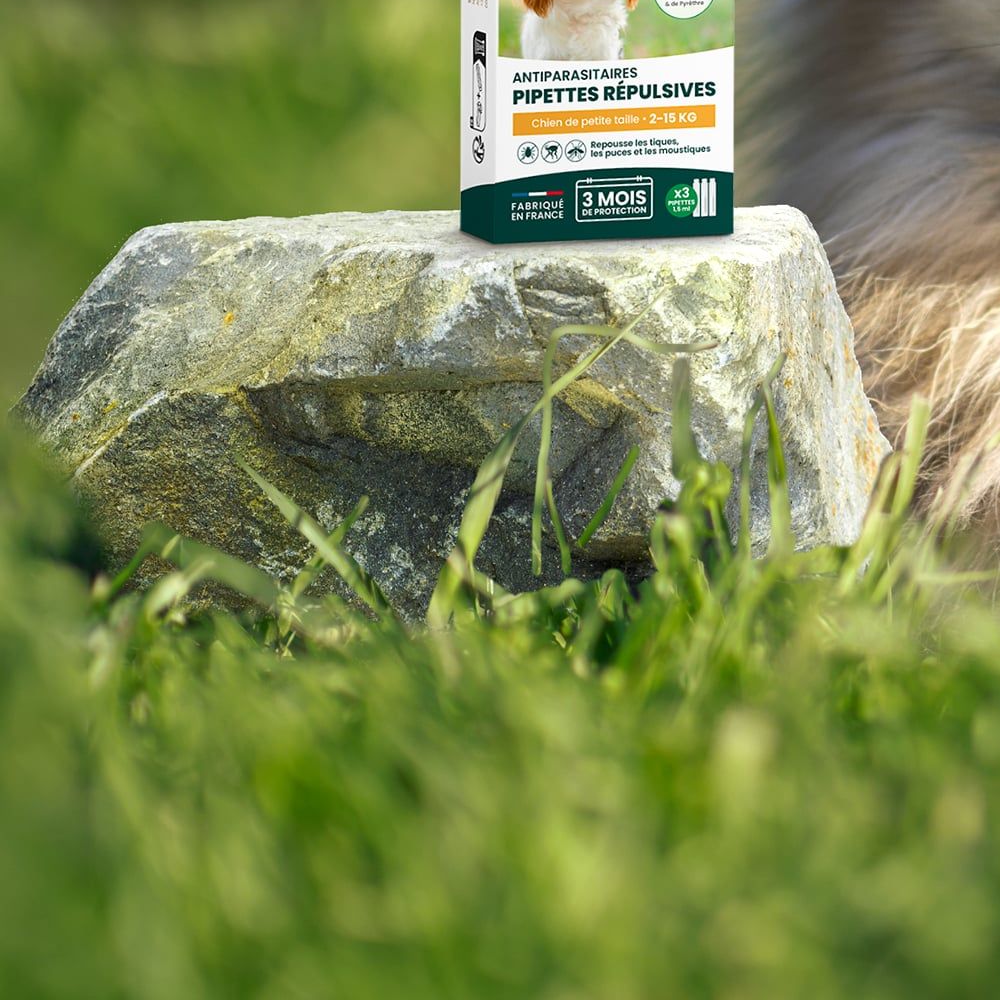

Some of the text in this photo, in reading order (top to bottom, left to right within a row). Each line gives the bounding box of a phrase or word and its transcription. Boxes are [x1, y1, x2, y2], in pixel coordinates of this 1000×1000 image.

[513, 67, 638, 83] ANTIPARASITAIRES
[513, 81, 716, 105] PIPETTES RÉPULSIVES
[532, 118, 562, 128] Chien
[565, 117, 578, 127] de
[581, 114, 612, 128] petite
[614, 113, 640, 125] taille
[679, 111, 697, 123] KG
[591, 137, 679, 150] Repousse les tiques,
[591, 144, 711, 159] les puces et les moustiques
[582, 189, 647, 208] 3 MOIS
[674, 186, 690, 199] x3
[511, 198, 564, 211] FABRIQUÉ
[582, 206, 647, 216] DE PROTECTION
[511, 210, 564, 221] EN FRANCE
